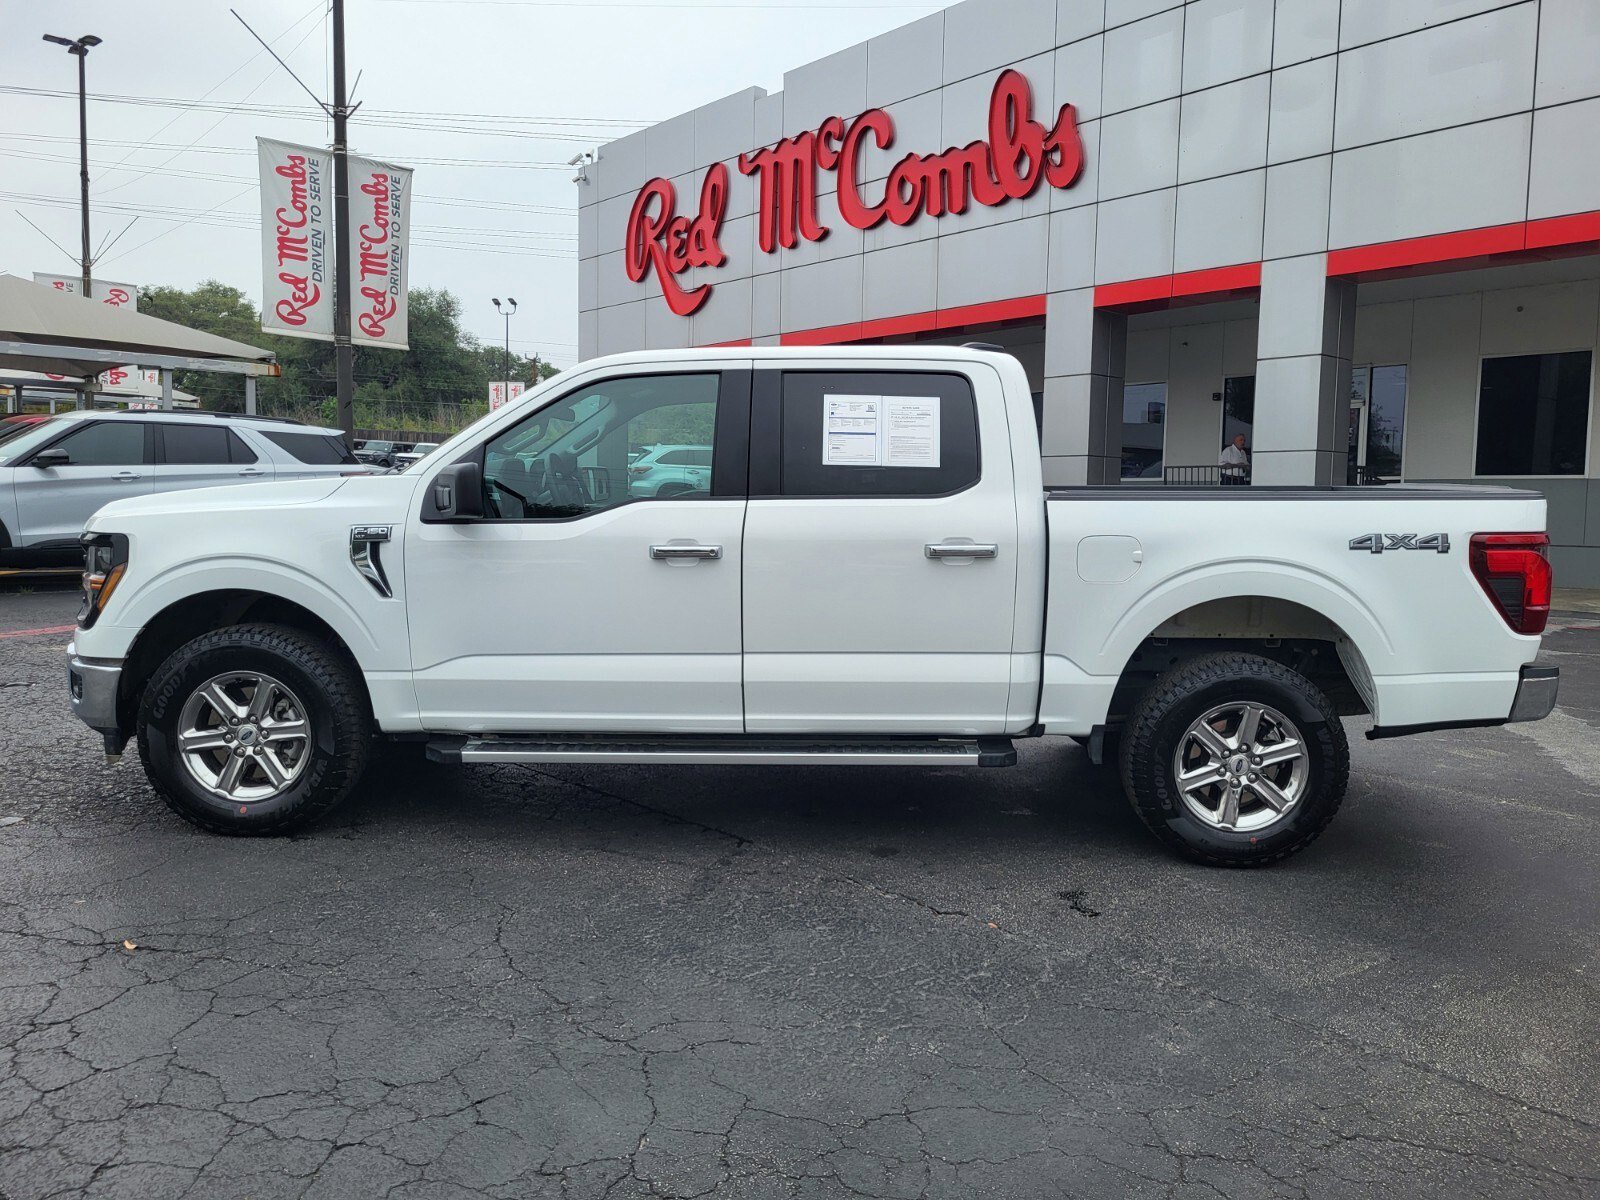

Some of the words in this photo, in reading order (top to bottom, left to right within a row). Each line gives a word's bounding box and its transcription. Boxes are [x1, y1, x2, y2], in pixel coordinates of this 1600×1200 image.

[308, 157, 322, 202] SERVE
[391, 175, 401, 218] SERVE
[625, 176, 730, 316] Red
[737, 68, 1086, 254] McCombs
[275, 154, 308, 267] McCombs
[310, 204, 322, 224] TO
[359, 173, 390, 282] McCombs
[391, 221, 401, 239] TO
[311, 229, 323, 283] DRIVEN
[390, 243, 400, 296] DRIVEN
[275, 272, 320, 326] Red
[358, 286, 397, 338] Red
